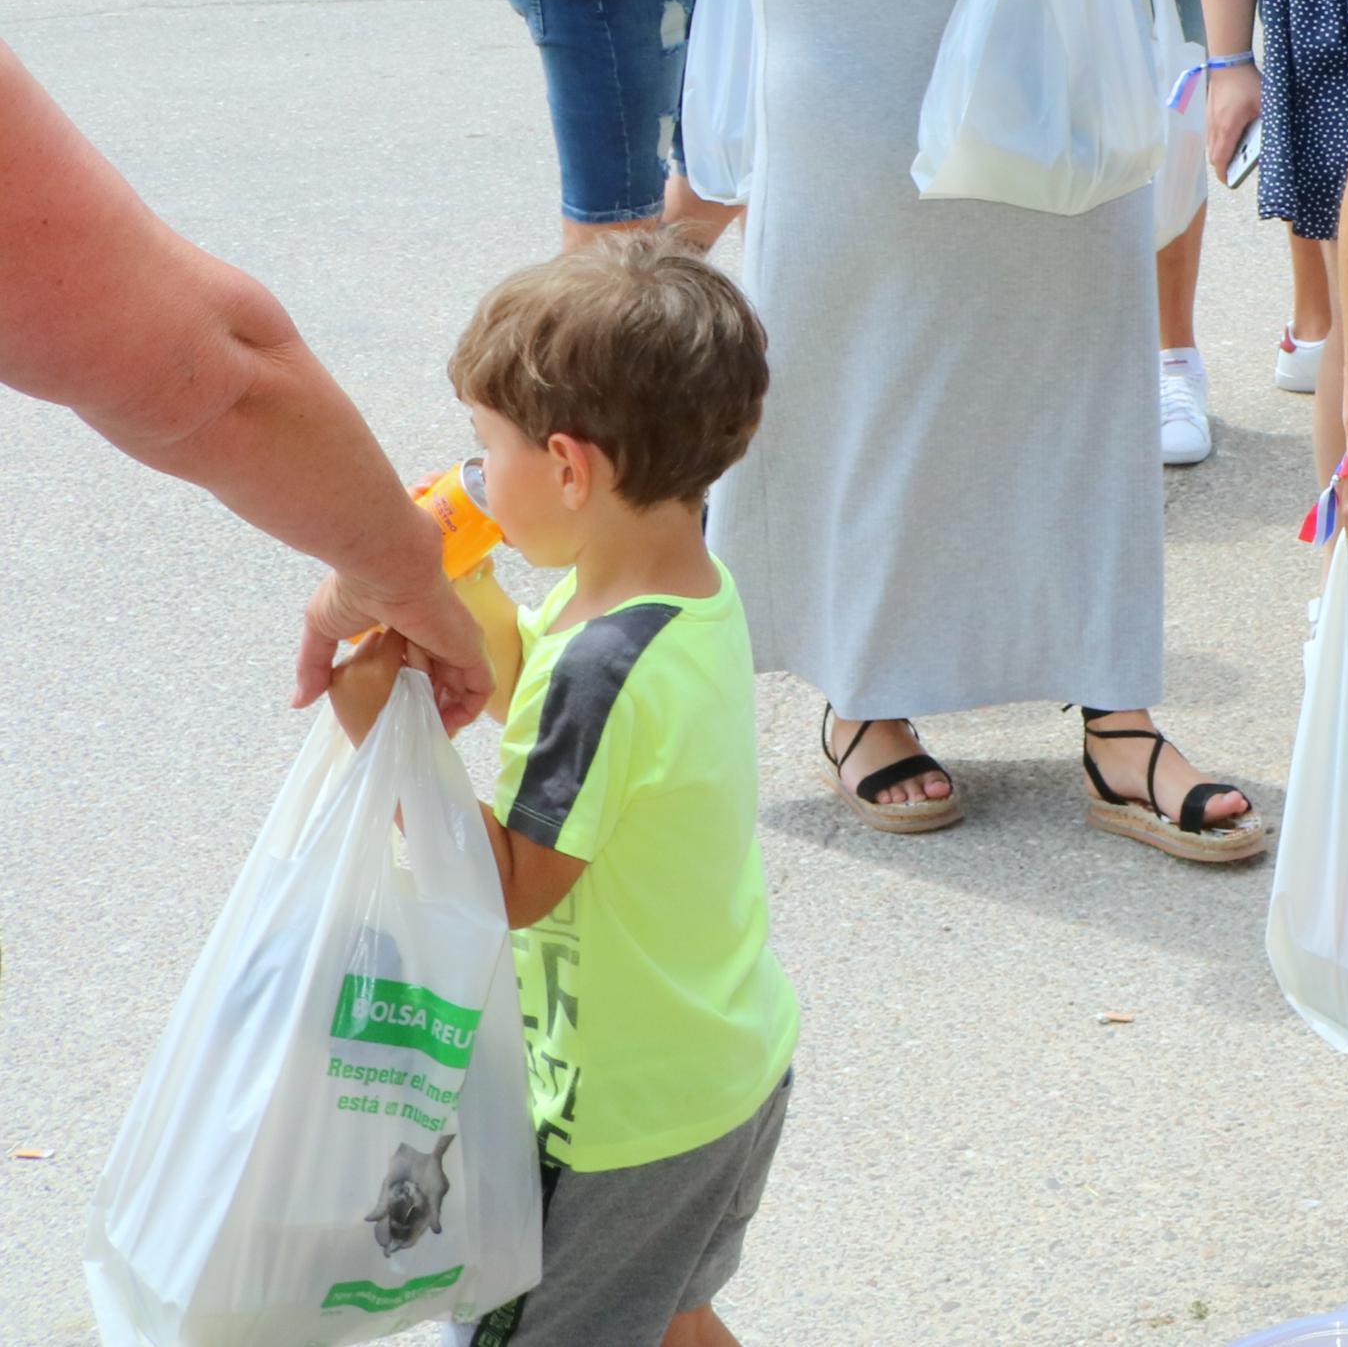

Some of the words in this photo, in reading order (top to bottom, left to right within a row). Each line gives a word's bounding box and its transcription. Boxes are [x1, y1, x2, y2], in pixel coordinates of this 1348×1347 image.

[351, 998, 428, 1030] BOLSA
[326, 1056, 408, 1087] Respetar
[410, 1073, 427, 1092] el
[337, 1095, 380, 1115] está
